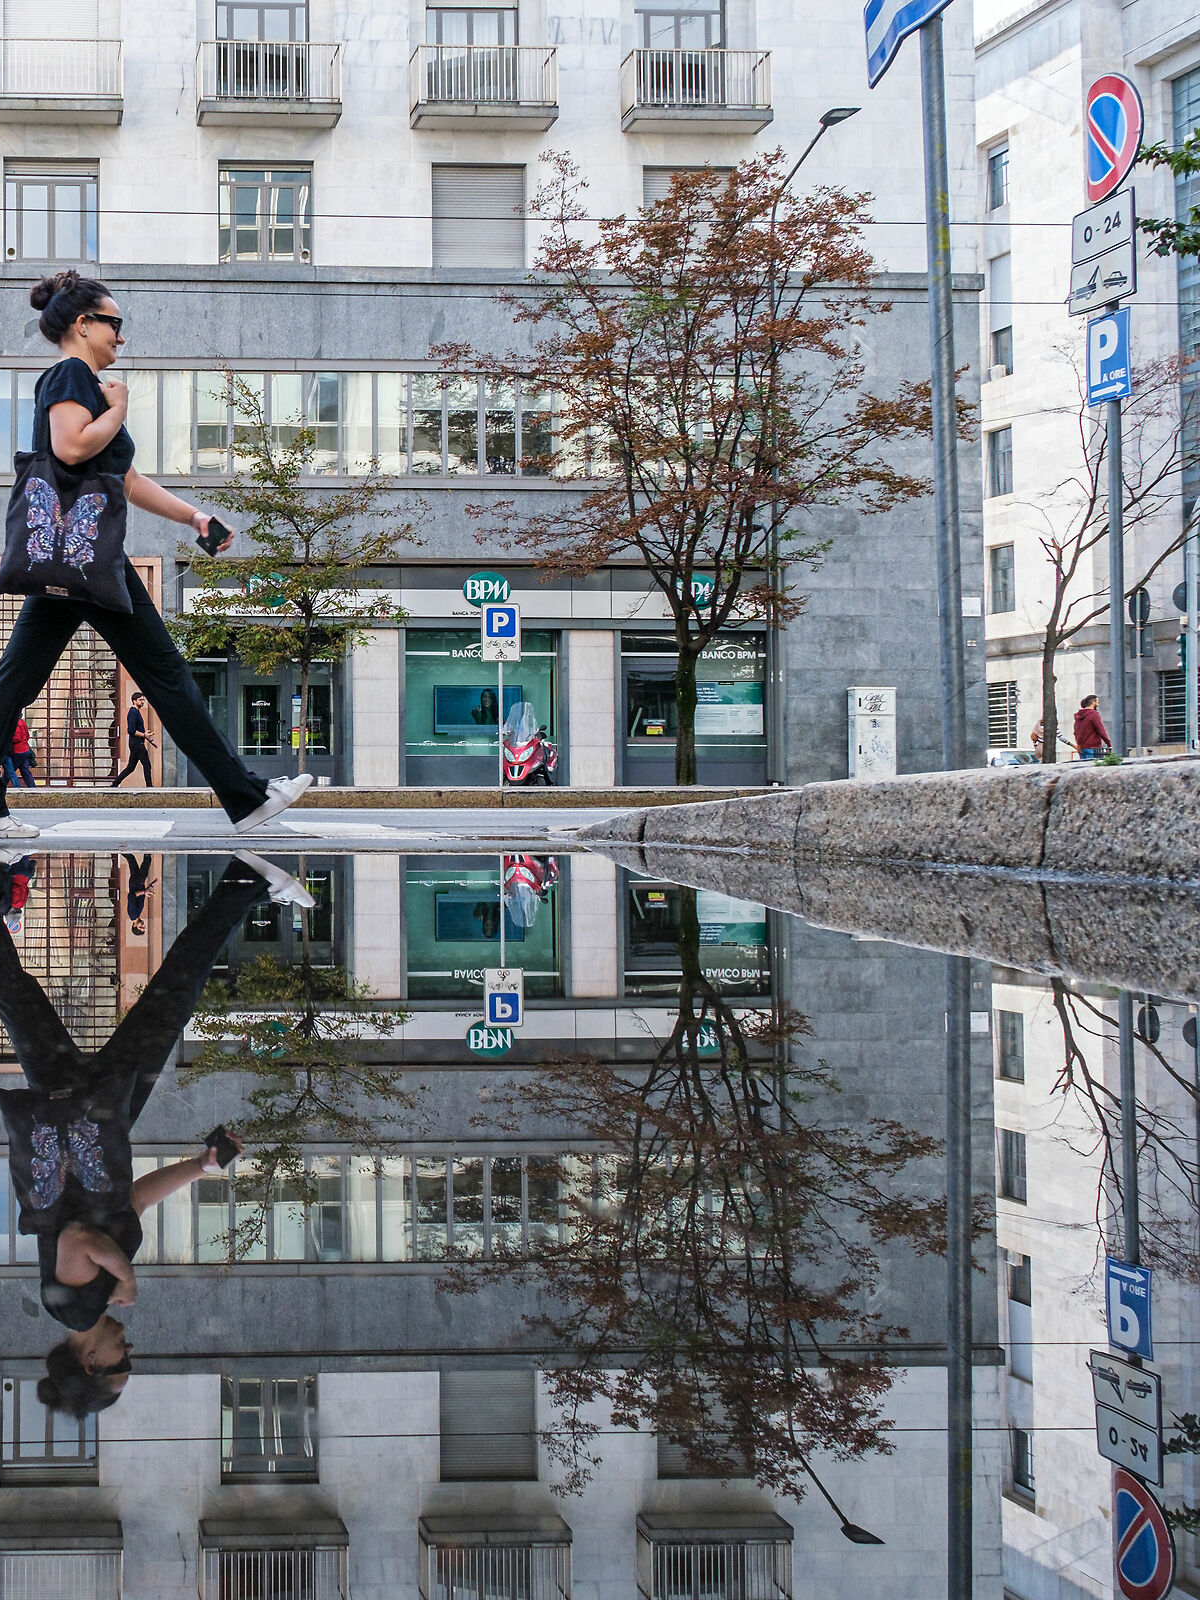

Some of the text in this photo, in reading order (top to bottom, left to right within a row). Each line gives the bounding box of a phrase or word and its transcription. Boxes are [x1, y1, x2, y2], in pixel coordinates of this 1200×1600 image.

[1104, 210, 1121, 234] 24
[1090, 319, 1118, 386] P
[1102, 372, 1109, 383] A
[466, 579, 508, 600] BPM
[493, 613, 509, 633] P
[452, 649, 481, 658] BANC
[702, 651, 756, 659] BANCO BPM
